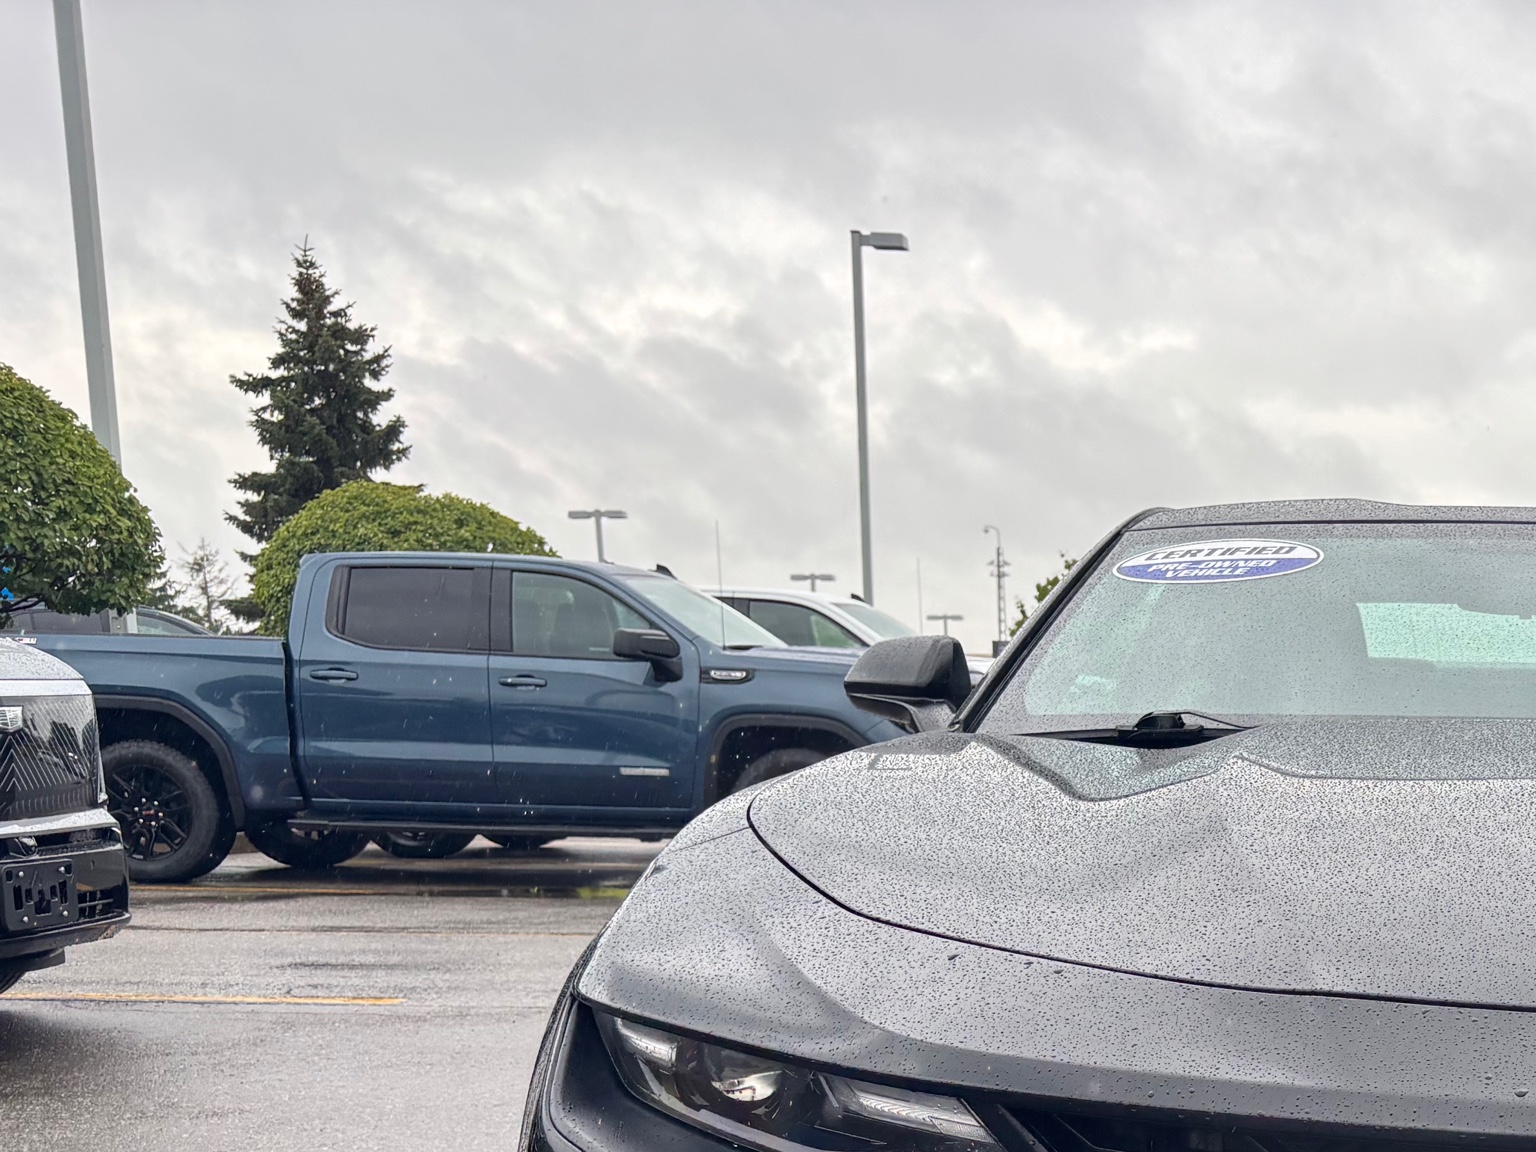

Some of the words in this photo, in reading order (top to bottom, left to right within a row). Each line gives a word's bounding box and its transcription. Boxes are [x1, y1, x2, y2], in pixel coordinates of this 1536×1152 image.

[1144, 546, 1298, 561] CERTIFIED
[1147, 560, 1277, 573] PRE-OWNED
[1165, 568, 1251, 578] VEHICLE
